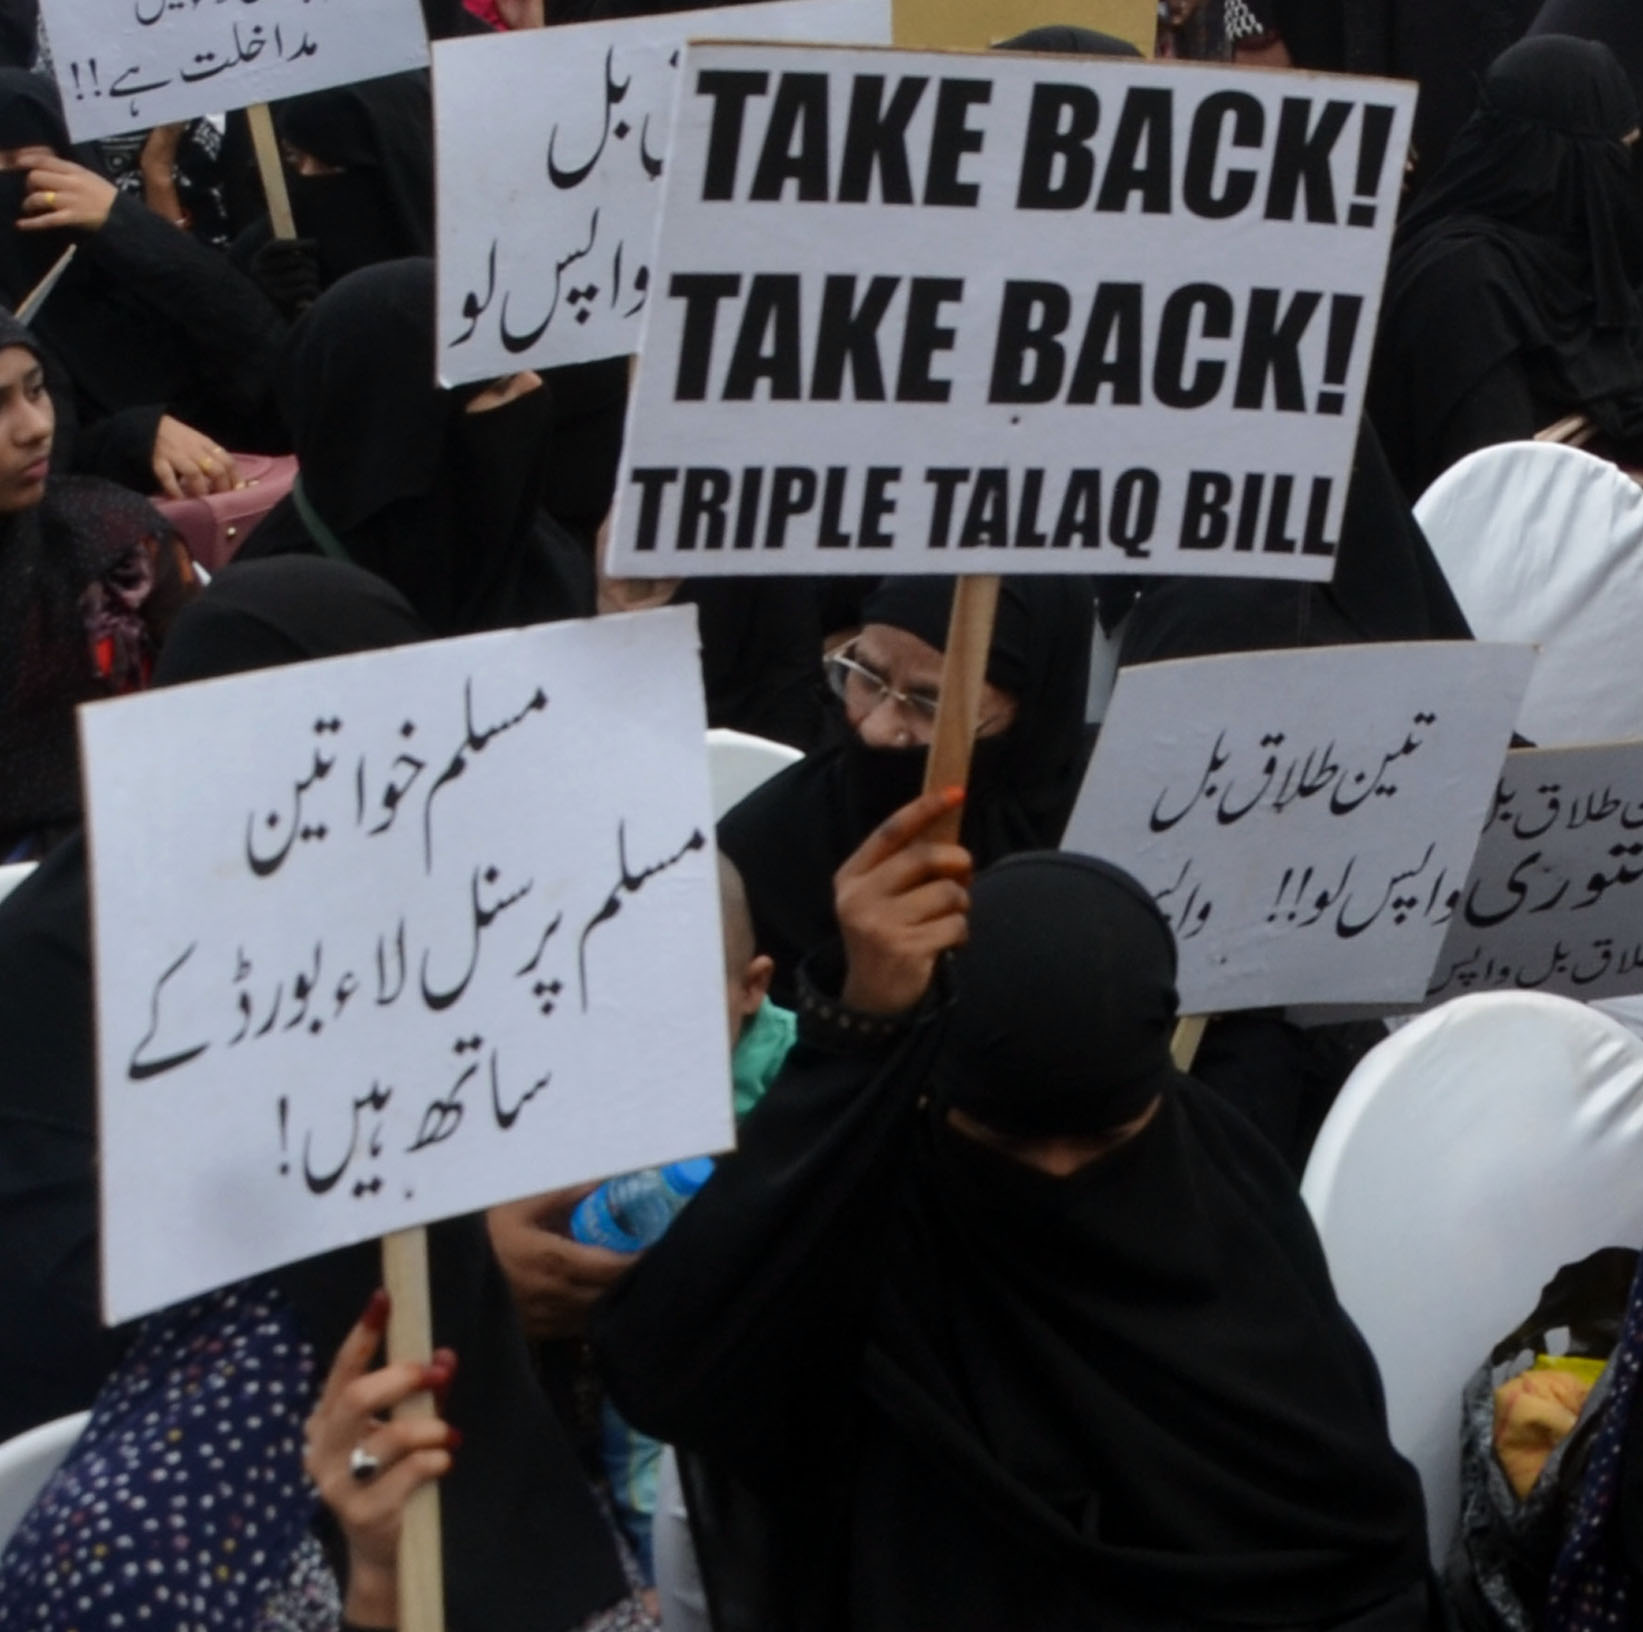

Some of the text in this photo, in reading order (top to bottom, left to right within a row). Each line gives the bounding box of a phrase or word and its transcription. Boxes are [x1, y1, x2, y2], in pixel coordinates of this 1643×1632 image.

[179, 21, 319, 81] مداخلت
[547, 43, 631, 190] بل
[697, 69, 1396, 229] TAKE BACK!
[448, 237, 499, 349] لو
[669, 272, 1365, 416] TAKE BACK!
[631, 465, 1336, 558] TRIPLE TALAQ BILL
[245, 675, 549, 879] مسلم خواتین
[1149, 712, 1437, 833] تین طلاق بل
[1512, 783, 1621, 840] طلاق
[419, 863, 565, 1016] پرسنل
[577, 818, 707, 1014] مسلم
[1335, 840, 1462, 939] واپس
[126, 940, 210, 1082] کے
[227, 937, 323, 1047] بورڈ
[1513, 940, 1570, 989] بل
[404, 1032, 554, 1153] ساتھ
